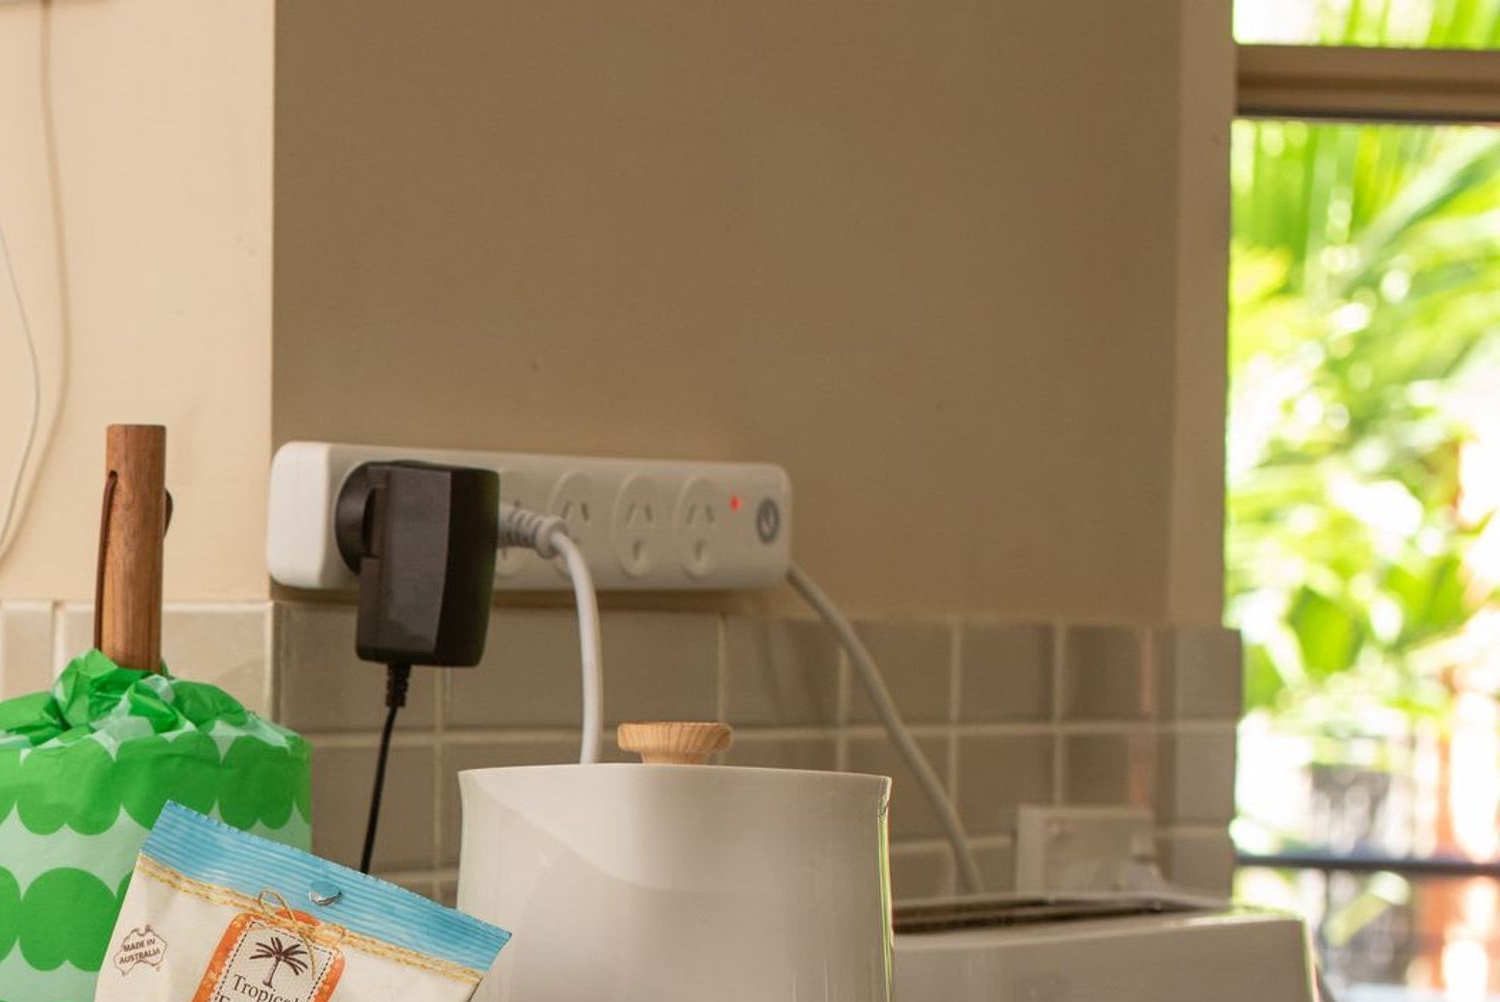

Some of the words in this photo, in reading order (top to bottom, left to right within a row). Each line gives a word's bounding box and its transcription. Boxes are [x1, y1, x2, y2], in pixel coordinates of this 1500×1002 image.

[122, 940, 145, 952] MADE
[145, 937, 156, 946] IN
[118, 947, 161, 965] AUSTRALIA
